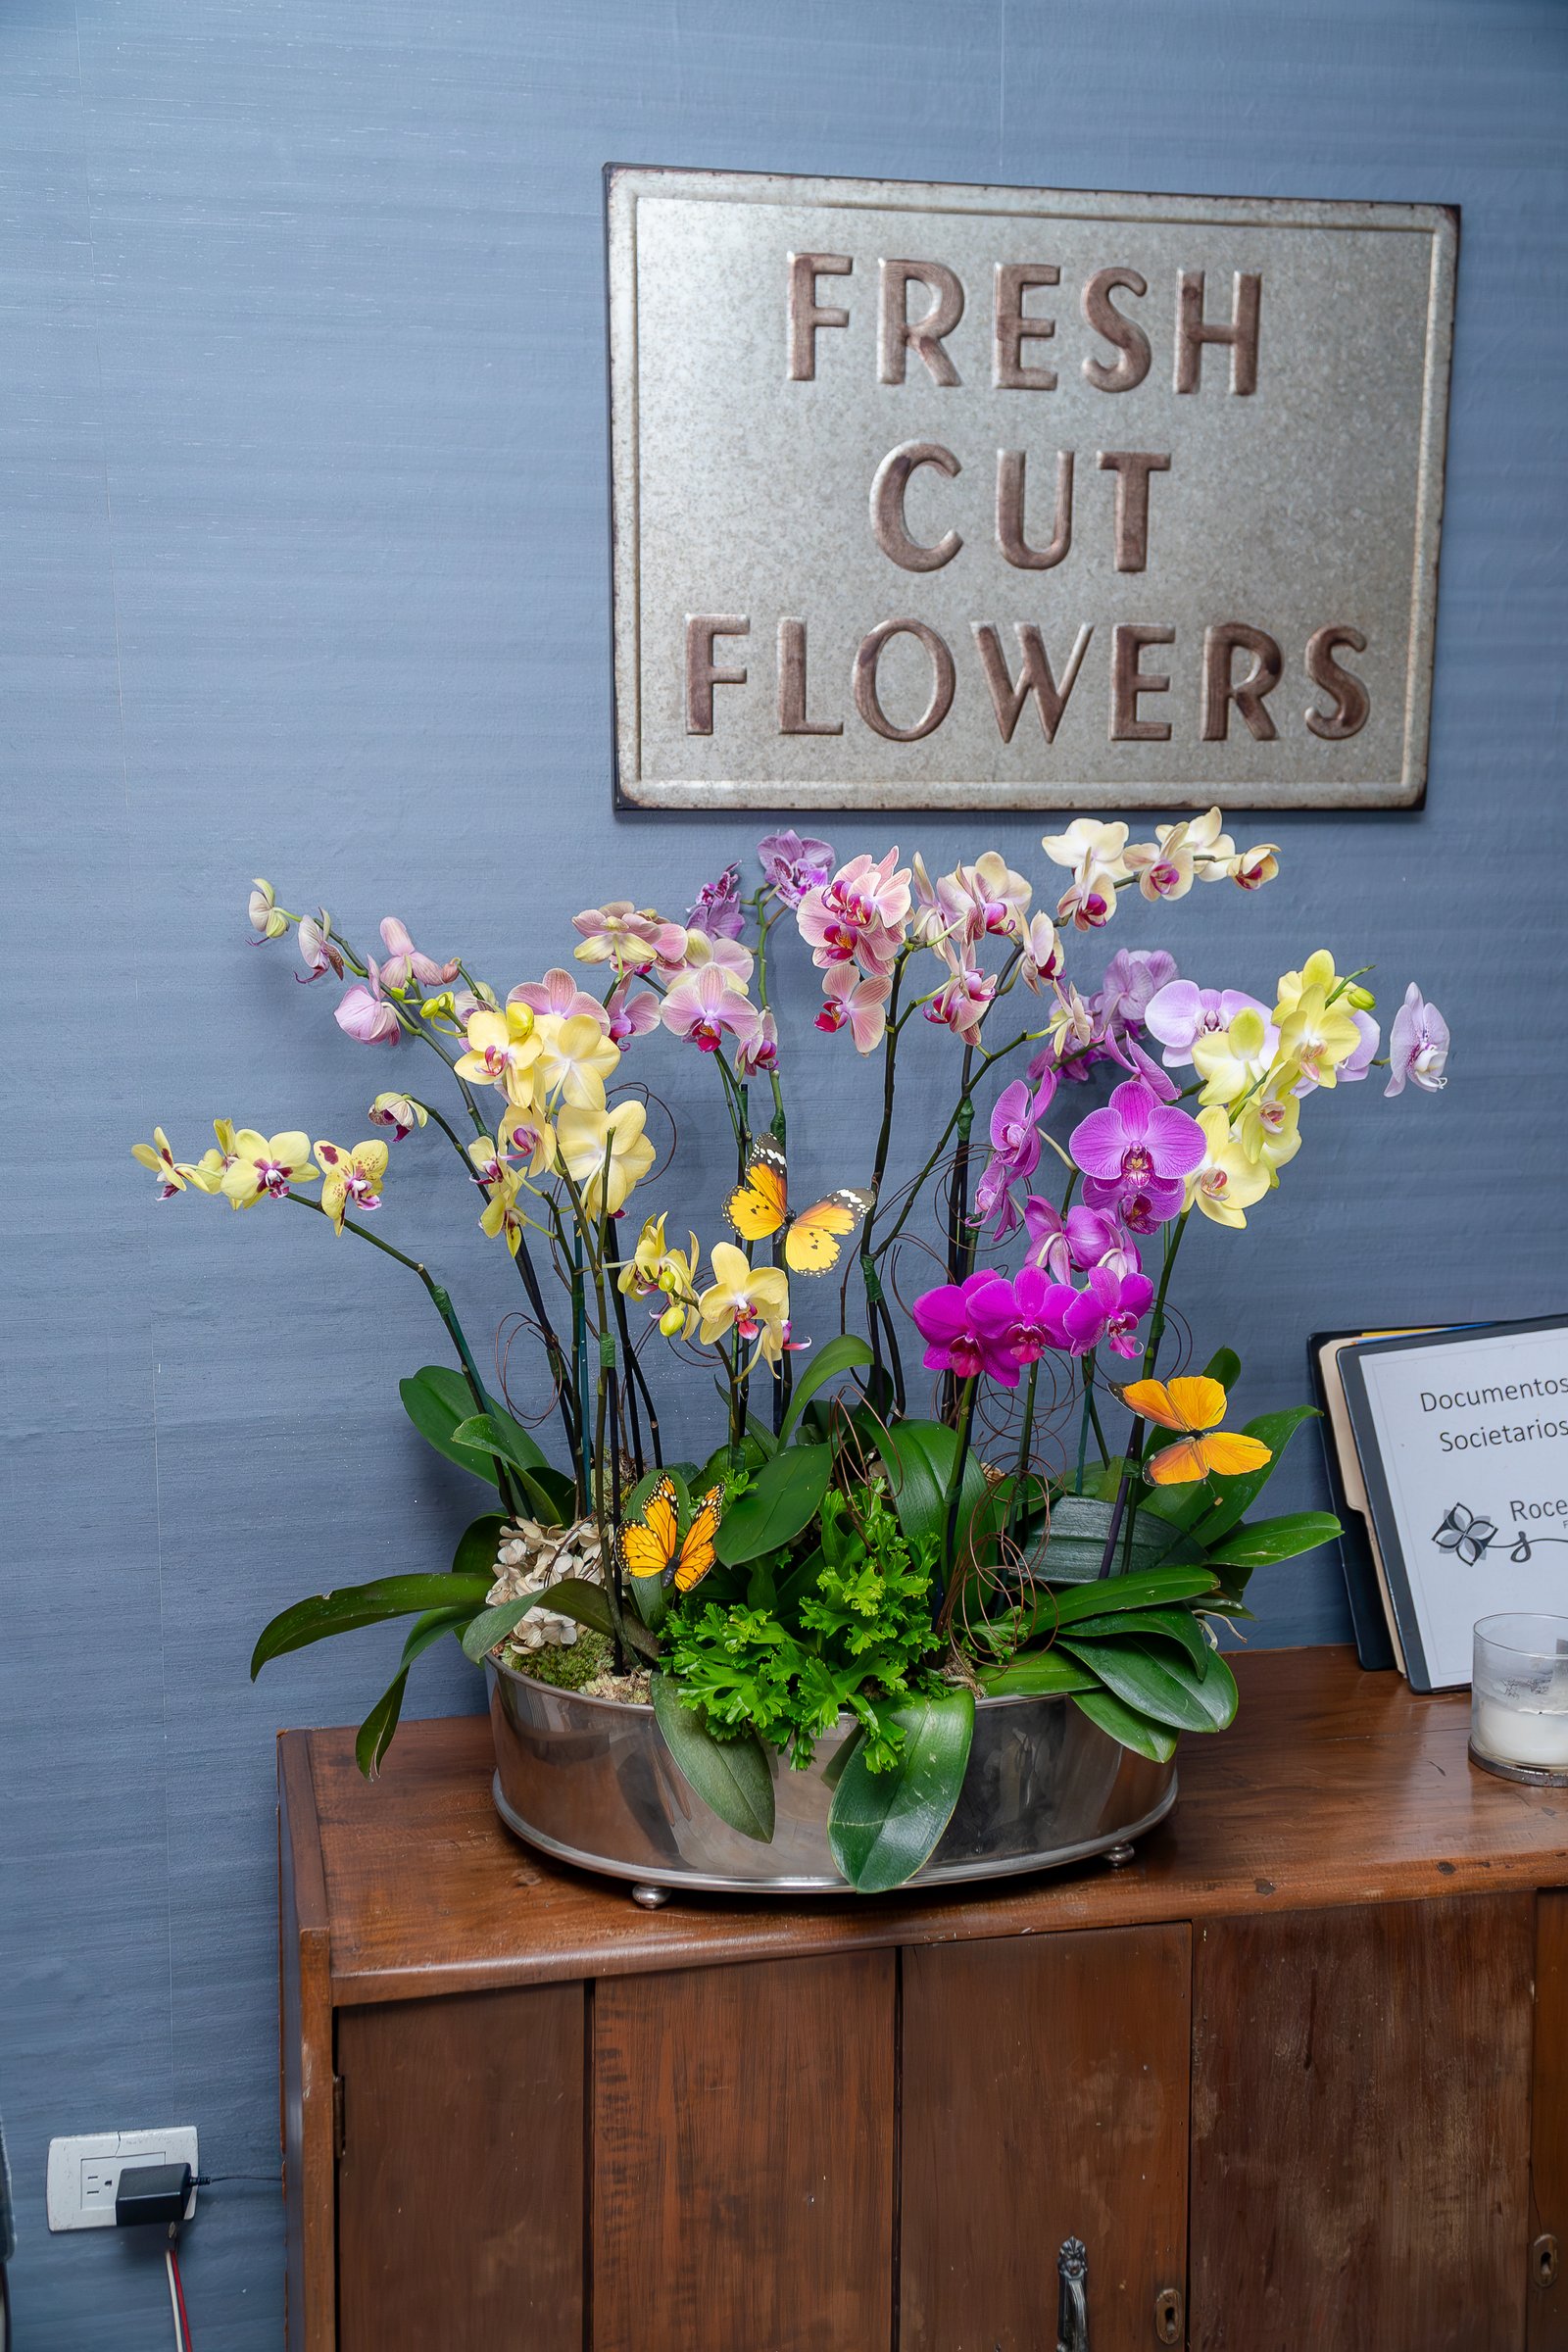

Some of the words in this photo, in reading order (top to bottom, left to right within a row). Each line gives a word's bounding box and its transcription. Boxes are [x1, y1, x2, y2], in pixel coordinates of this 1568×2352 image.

[786, 251, 1262, 397] FRESH
[870, 439, 1171, 574] CUT
[684, 612, 1370, 745] FLOWERS
[1420, 1377, 1568, 1412] Documentos
[1440, 1418, 1568, 1452] Societarios
[1509, 1498, 1568, 1522] Roce
